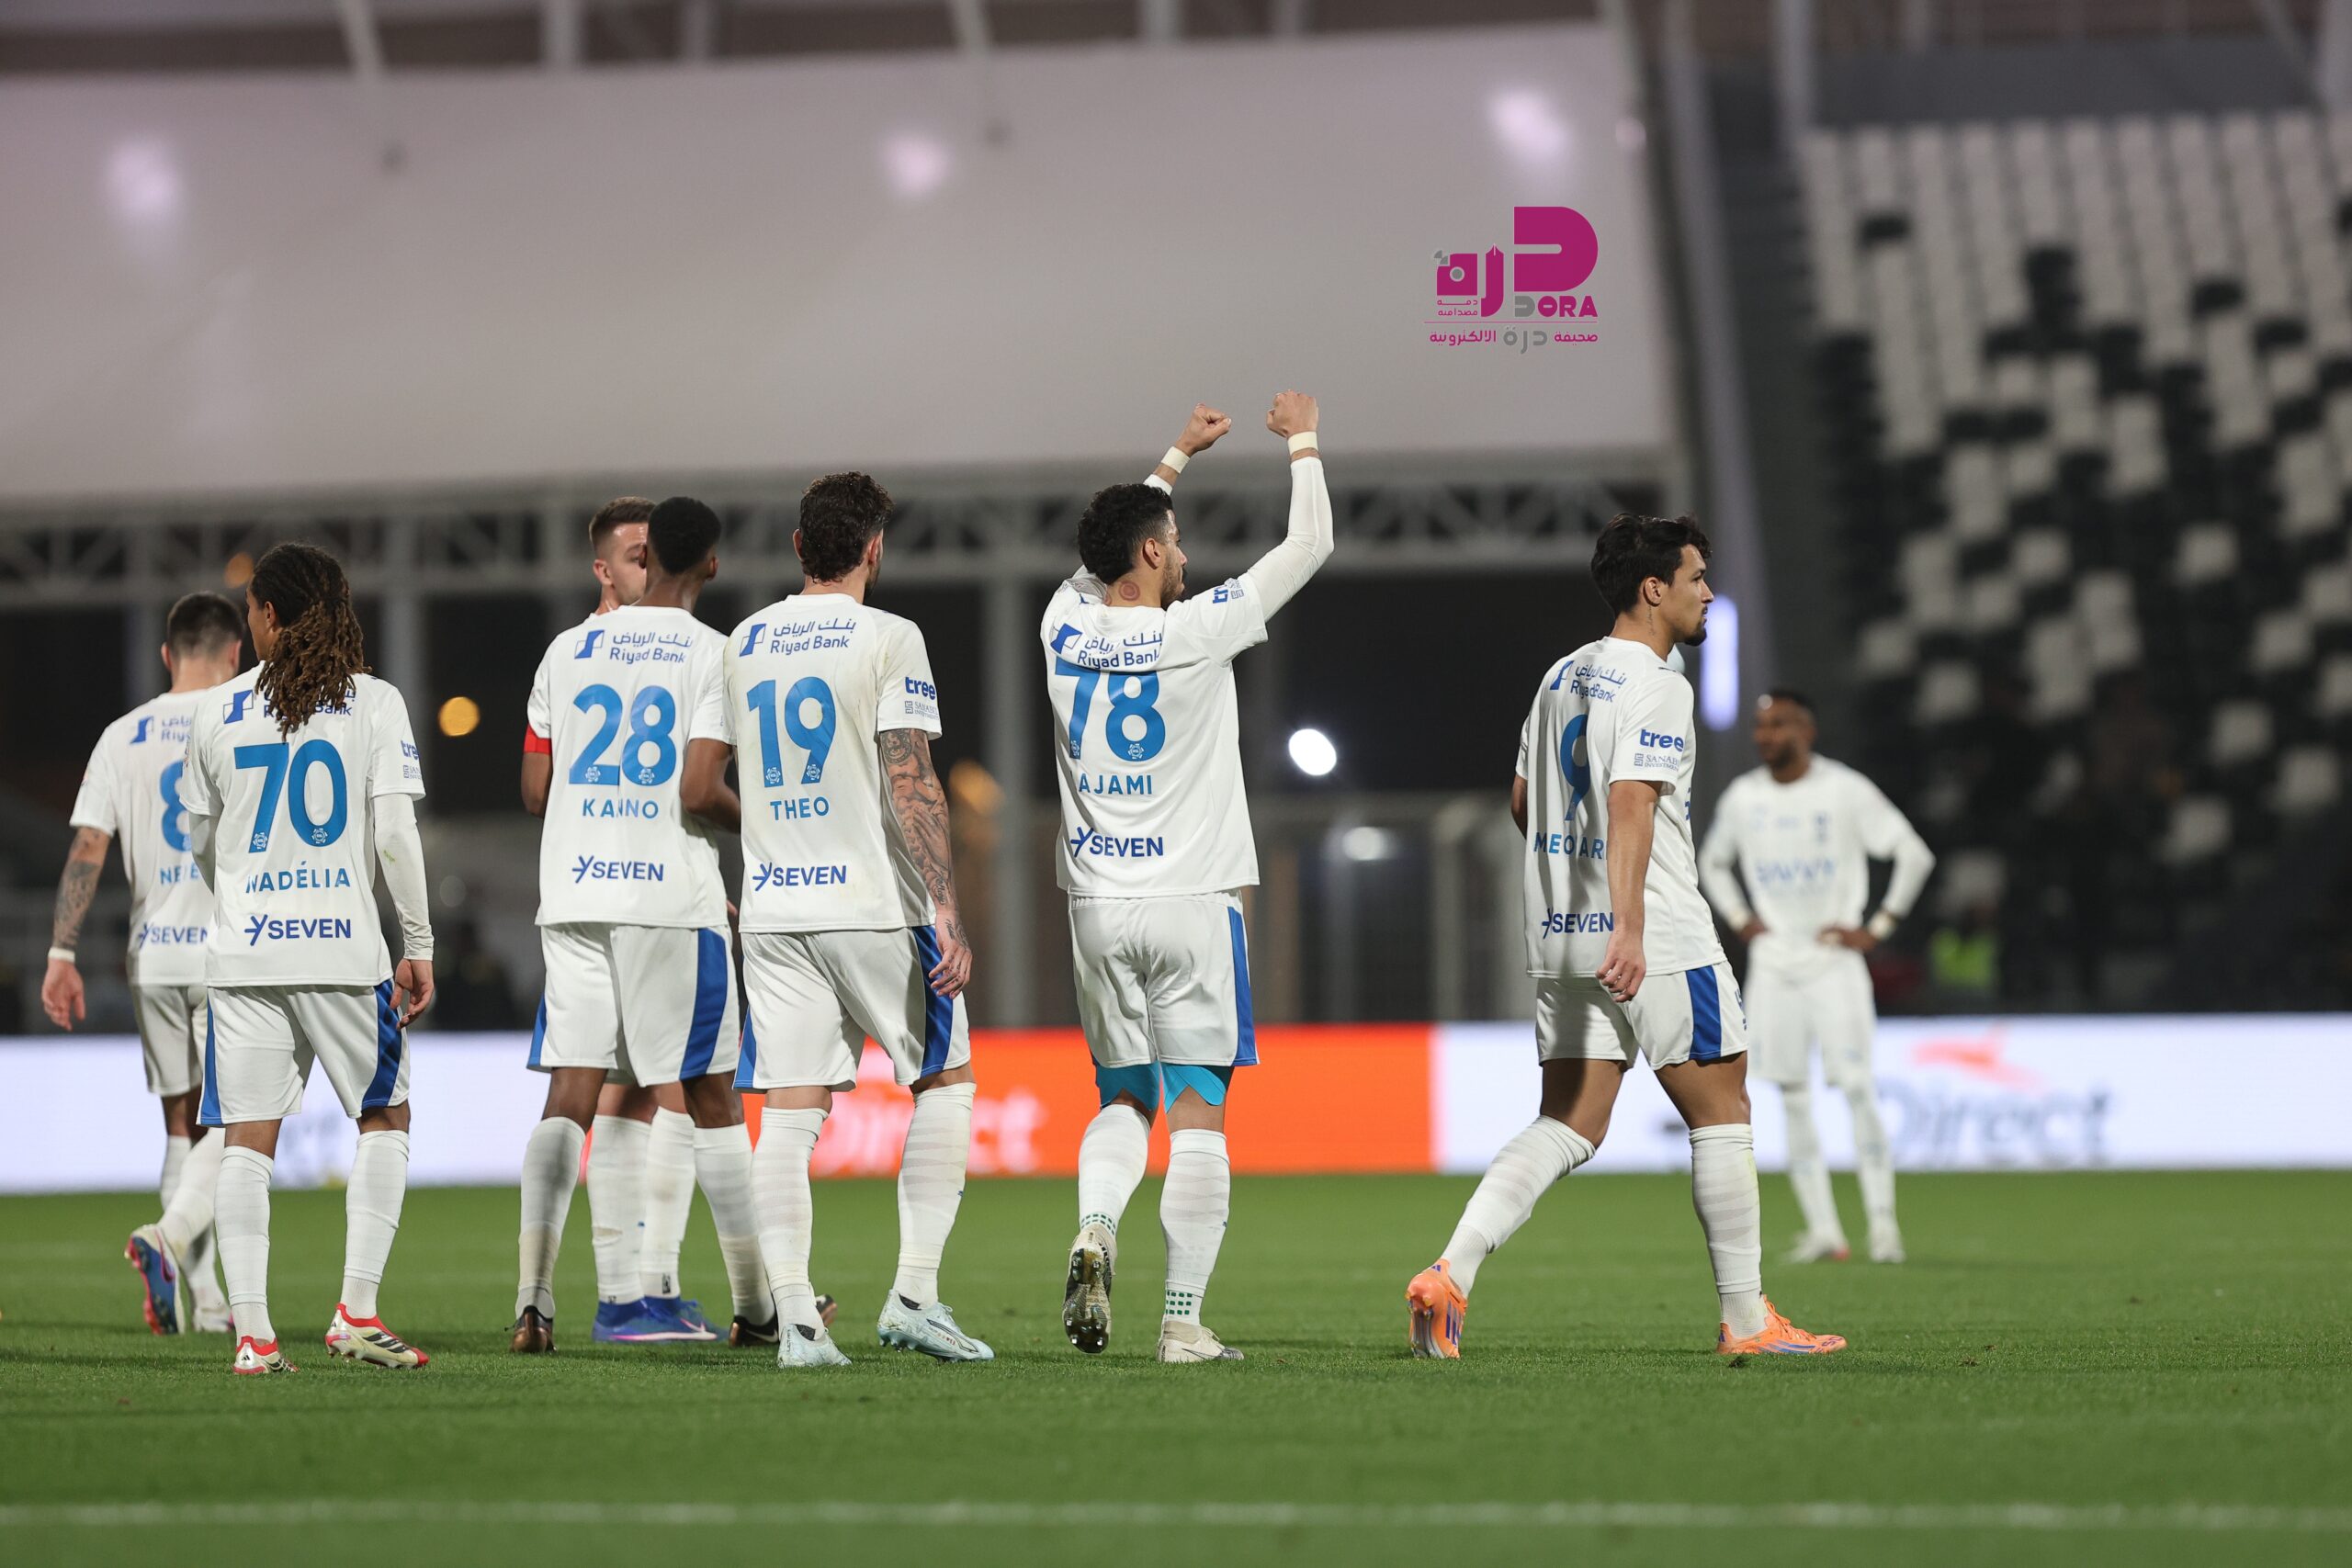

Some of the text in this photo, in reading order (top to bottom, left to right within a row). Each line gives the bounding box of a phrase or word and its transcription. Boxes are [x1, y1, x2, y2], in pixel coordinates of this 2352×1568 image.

[613, 632, 656, 647] الرياض
[774, 621, 816, 637] الرياض
[770, 635, 850, 655] Riyad Bank
[610, 647, 685, 665] Riyad Bank
[1078, 650, 1119, 670] Riyad
[905, 676, 936, 701] tree
[1054, 657, 1166, 762] 78
[569, 683, 676, 787] 28
[747, 676, 836, 788] 19
[1639, 728, 1684, 752] tree
[1560, 714, 1590, 820] 9
[1079, 774, 1152, 795] AJAMI
[233, 739, 347, 853] 70
[770, 796, 830, 820] THEO
[1090, 835, 1164, 856] SEVEN
[591, 861, 664, 882] SEVEN
[773, 865, 847, 886] SEVEN
[267, 919, 351, 940] SEVEN
[1552, 912, 1614, 933] SEVEN
